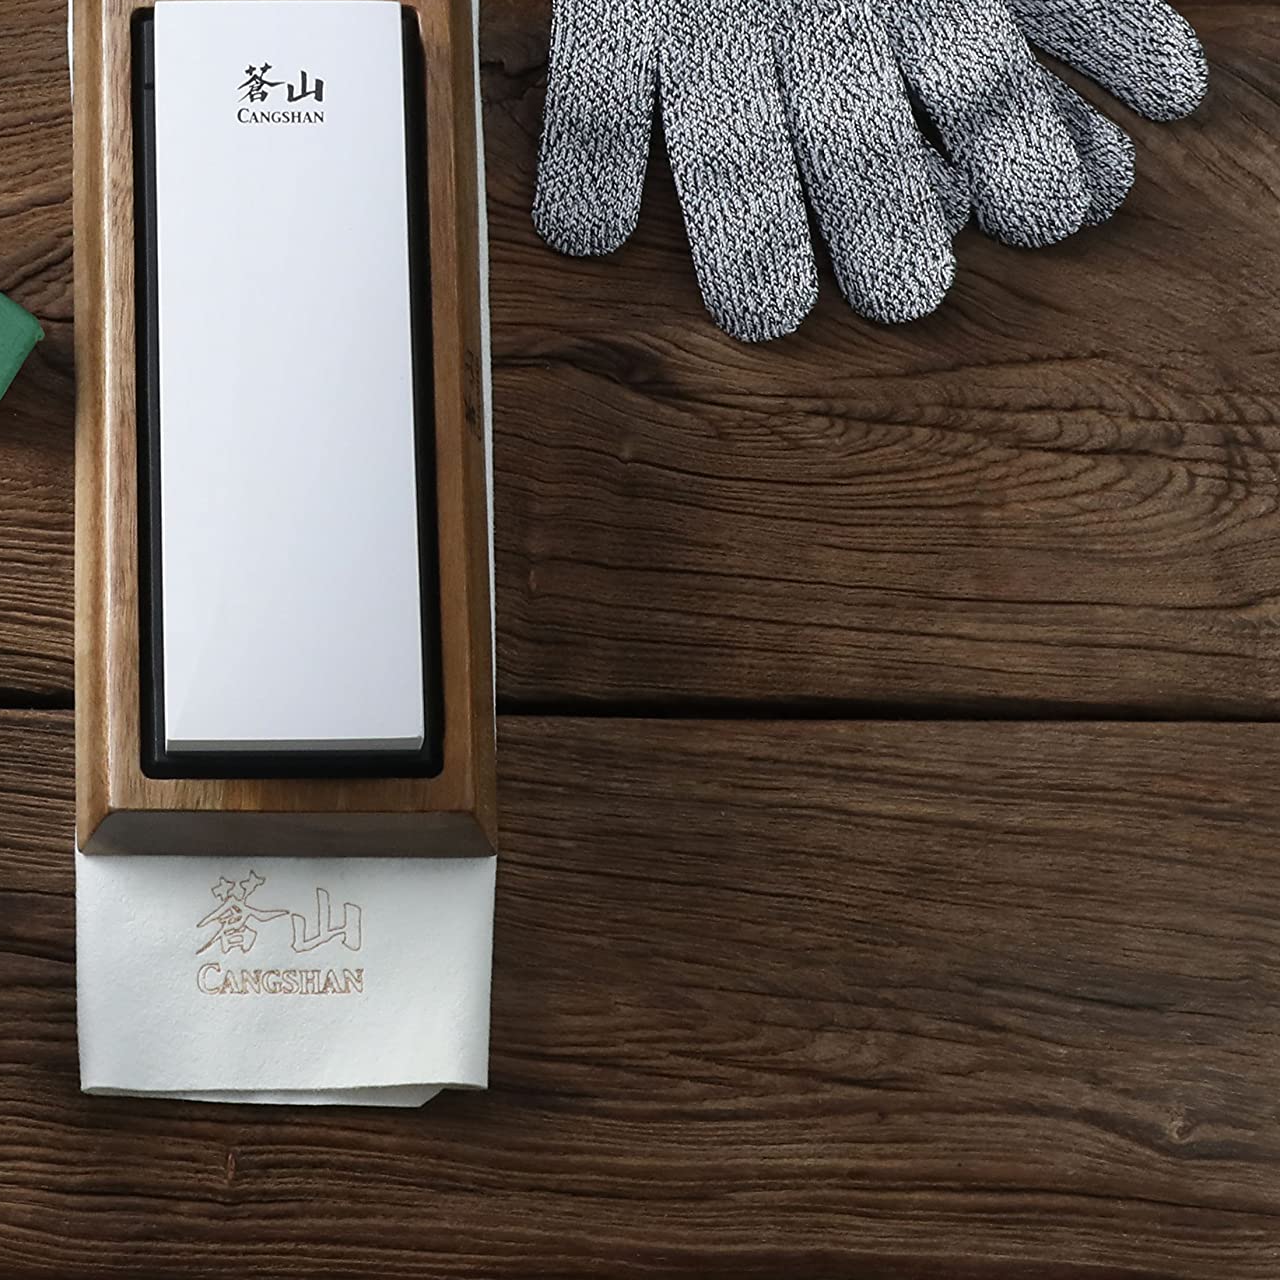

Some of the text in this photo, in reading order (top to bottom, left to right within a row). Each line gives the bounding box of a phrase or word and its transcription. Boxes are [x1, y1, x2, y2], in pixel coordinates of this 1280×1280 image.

[237, 62, 324, 102] 蒼山
[237, 108, 324, 123] CANGSHAN
[196, 962, 364, 995] CANGSHAN
